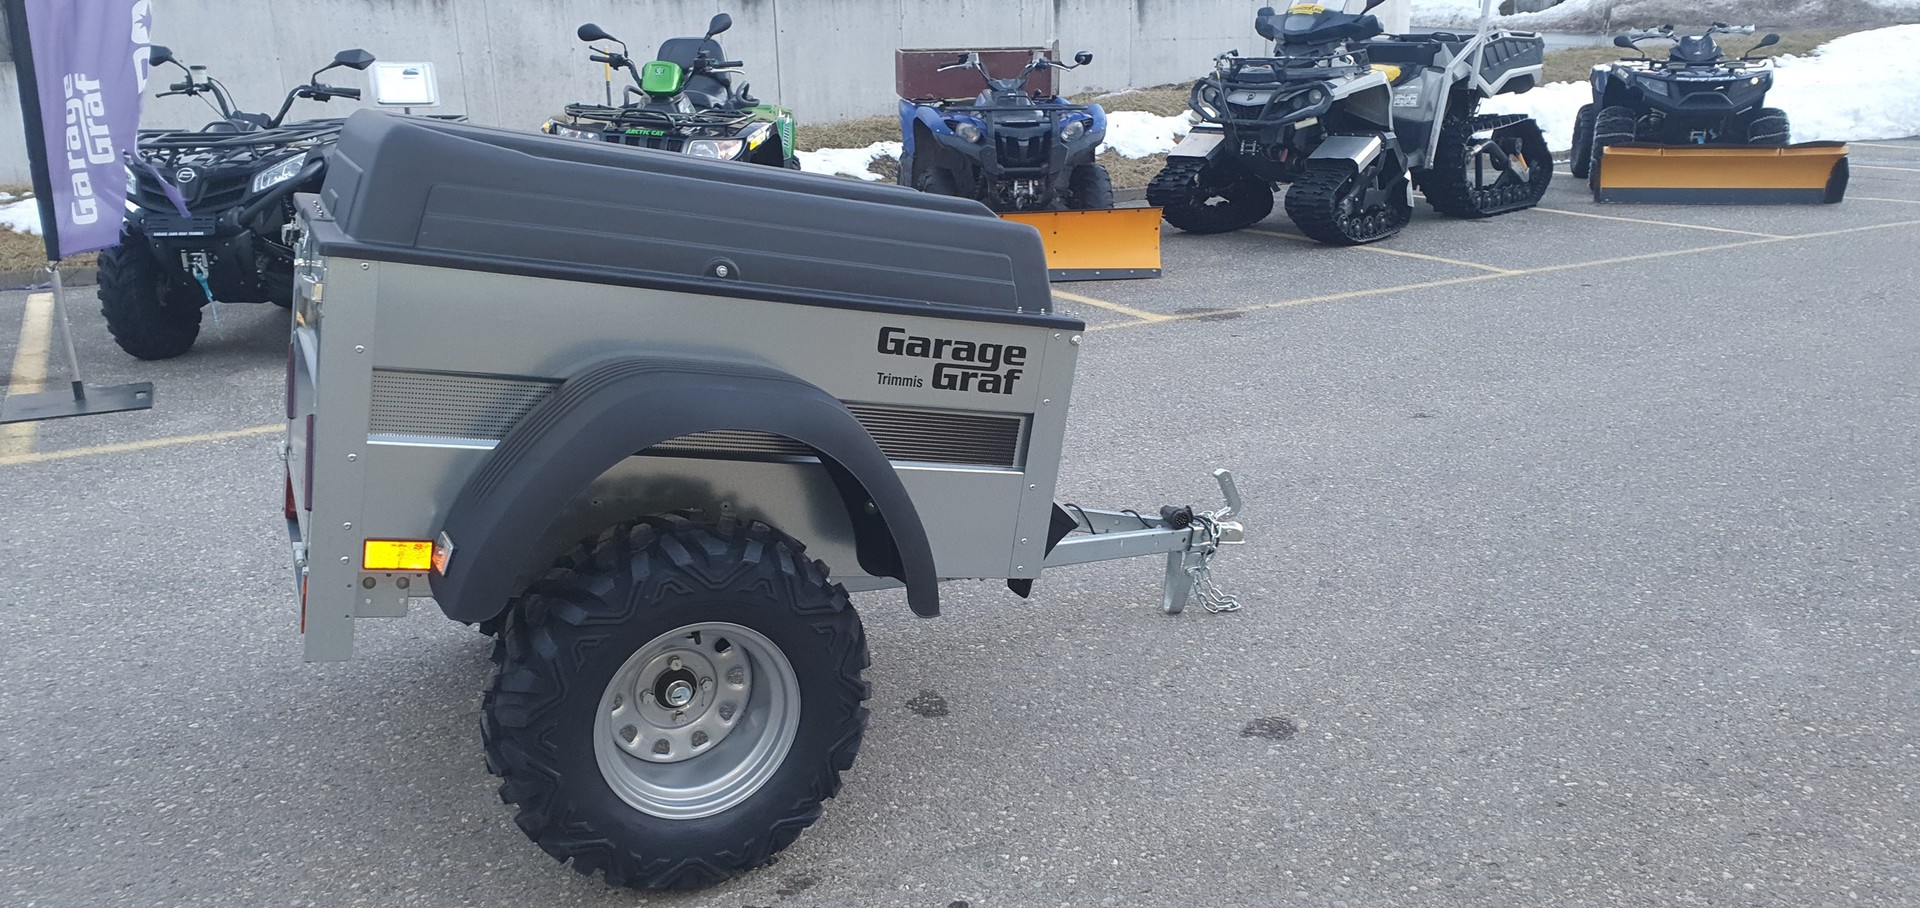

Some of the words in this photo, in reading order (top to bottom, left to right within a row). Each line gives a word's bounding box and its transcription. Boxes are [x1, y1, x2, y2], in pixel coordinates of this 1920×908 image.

[63, 73, 98, 225] Garage
[74, 73, 115, 164] Graf
[877, 326, 1027, 372] Garage
[877, 372, 924, 388] Trimmis
[931, 362, 1023, 395] Graf
